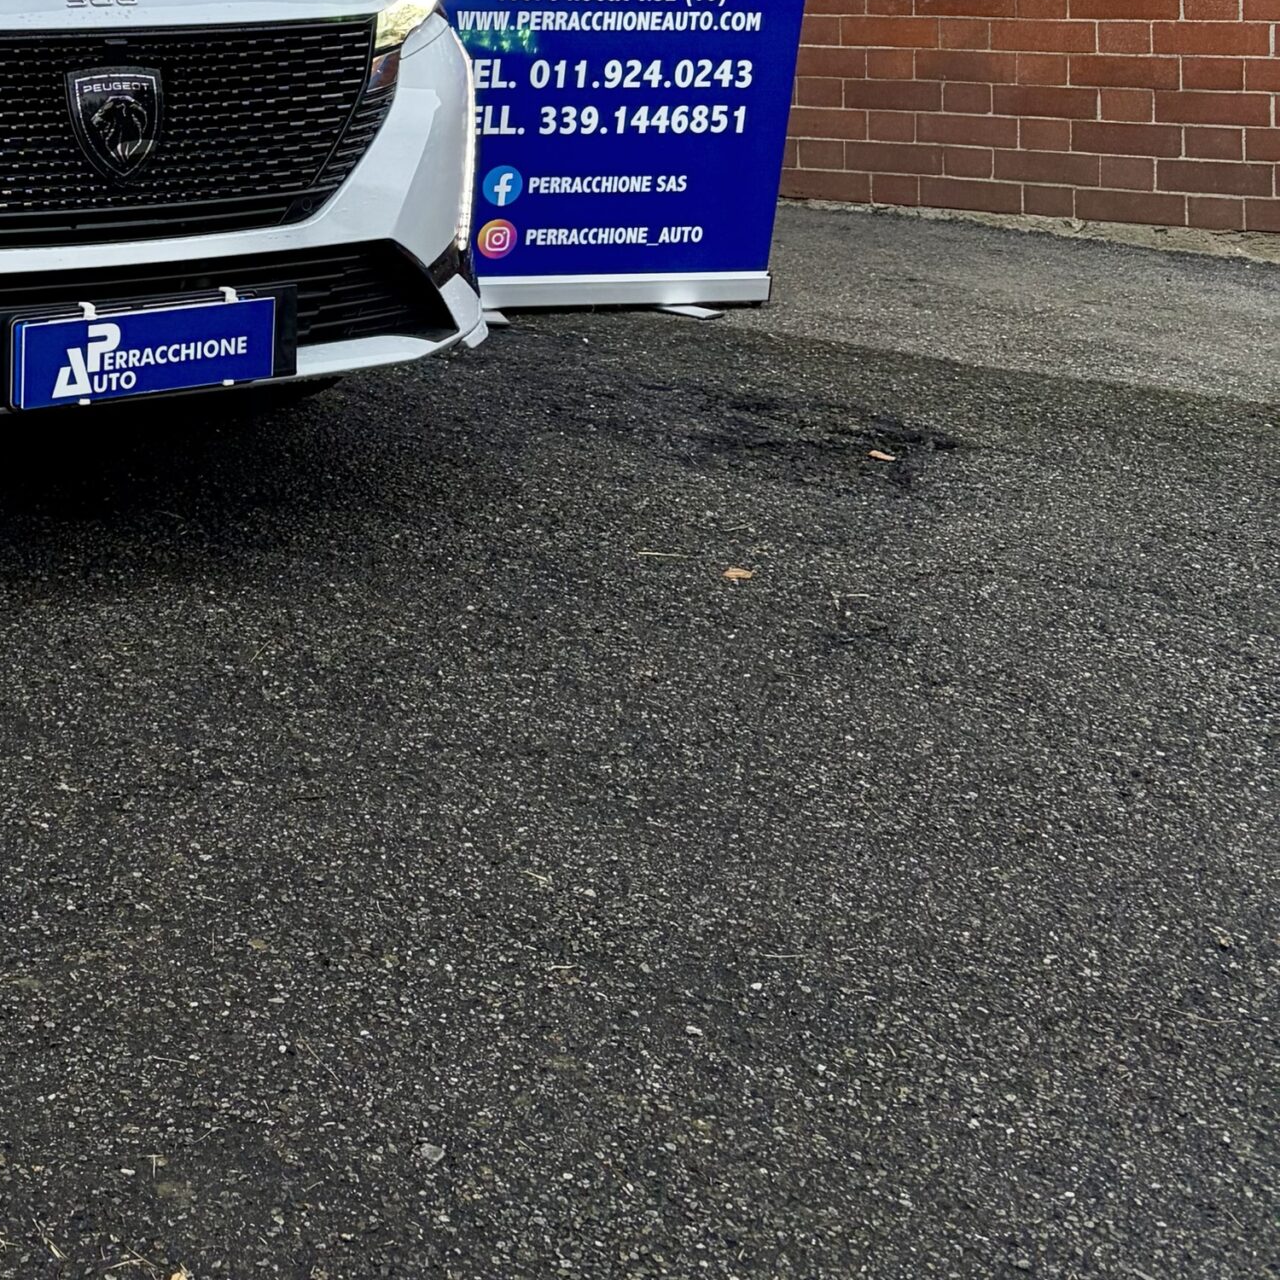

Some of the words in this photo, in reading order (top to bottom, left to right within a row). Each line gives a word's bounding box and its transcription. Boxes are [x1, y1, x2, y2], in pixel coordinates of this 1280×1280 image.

[456, 10, 762, 32] WWW.PERRACCHIONEAUTO.COM
[471, 58, 517, 89] EL.
[529, 58, 753, 89] 011.924.0243
[83, 81, 149, 93] PEUGEOT
[539, 105, 746, 135] 339.1446851
[528, 176, 651, 194] PERRACCHIONE
[656, 175, 687, 192] SAS
[525, 226, 703, 246] PERRACCHIONE_AUTO
[88, 323, 247, 372] PERRACCHIONE
[52, 348, 136, 399] AUTO
